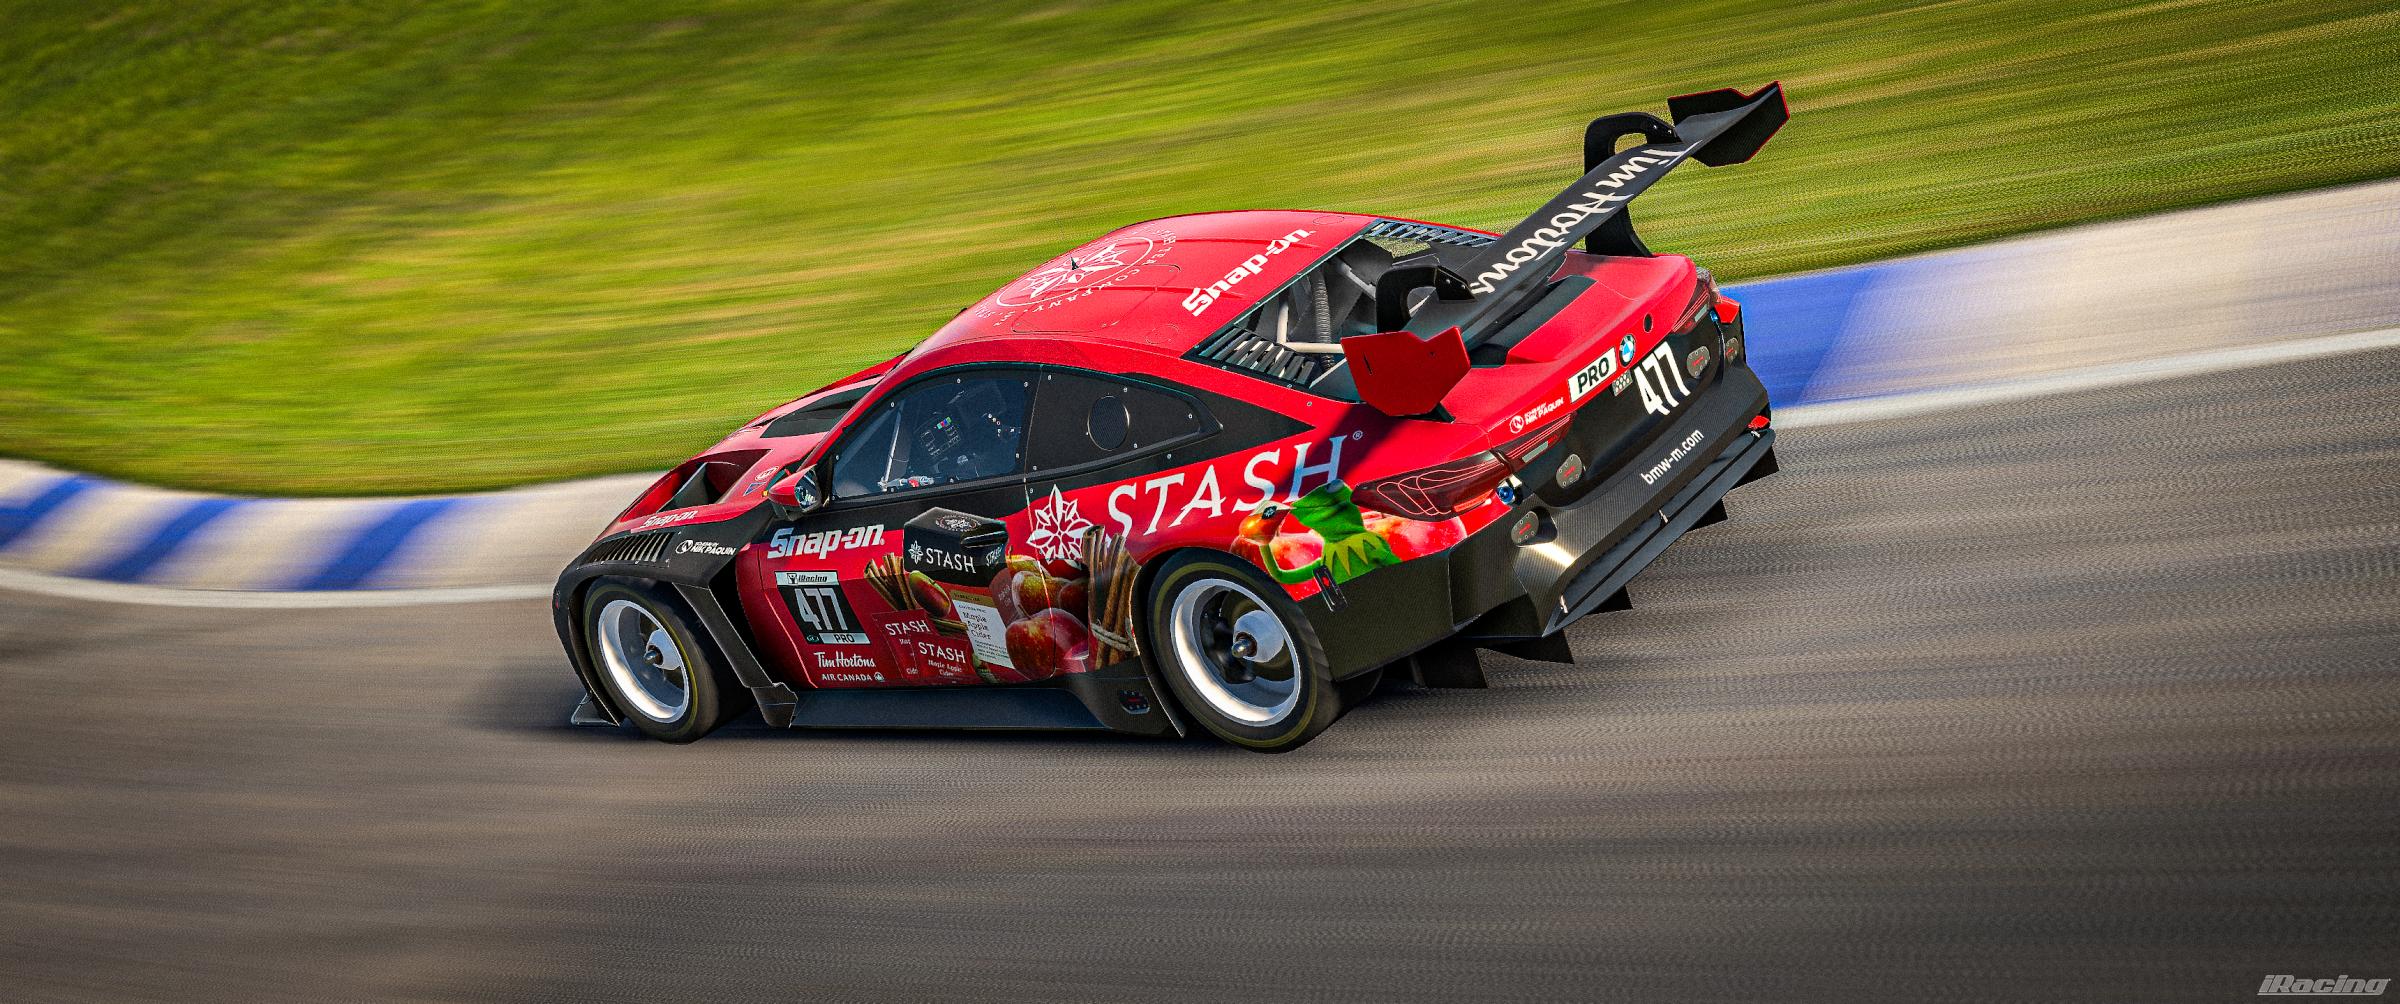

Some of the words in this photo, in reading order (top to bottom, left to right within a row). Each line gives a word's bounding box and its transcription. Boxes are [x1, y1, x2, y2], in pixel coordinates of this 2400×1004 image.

[1595, 140, 1706, 188] Tim
[1469, 192, 1634, 295] Hortons
[1576, 356, 1610, 395] PRO
[1633, 341, 1692, 417] 477
[1640, 428, 1704, 486] bmw-m.com
[704, 546, 736, 556] PAQUIN
[925, 547, 977, 573] STASH
[794, 588, 848, 631] 477
[834, 634, 855, 643] PRO
[884, 619, 930, 636] STASH
[814, 651, 836, 668] Tim
[836, 651, 876, 668] Hortons
[918, 641, 967, 664] STASH
